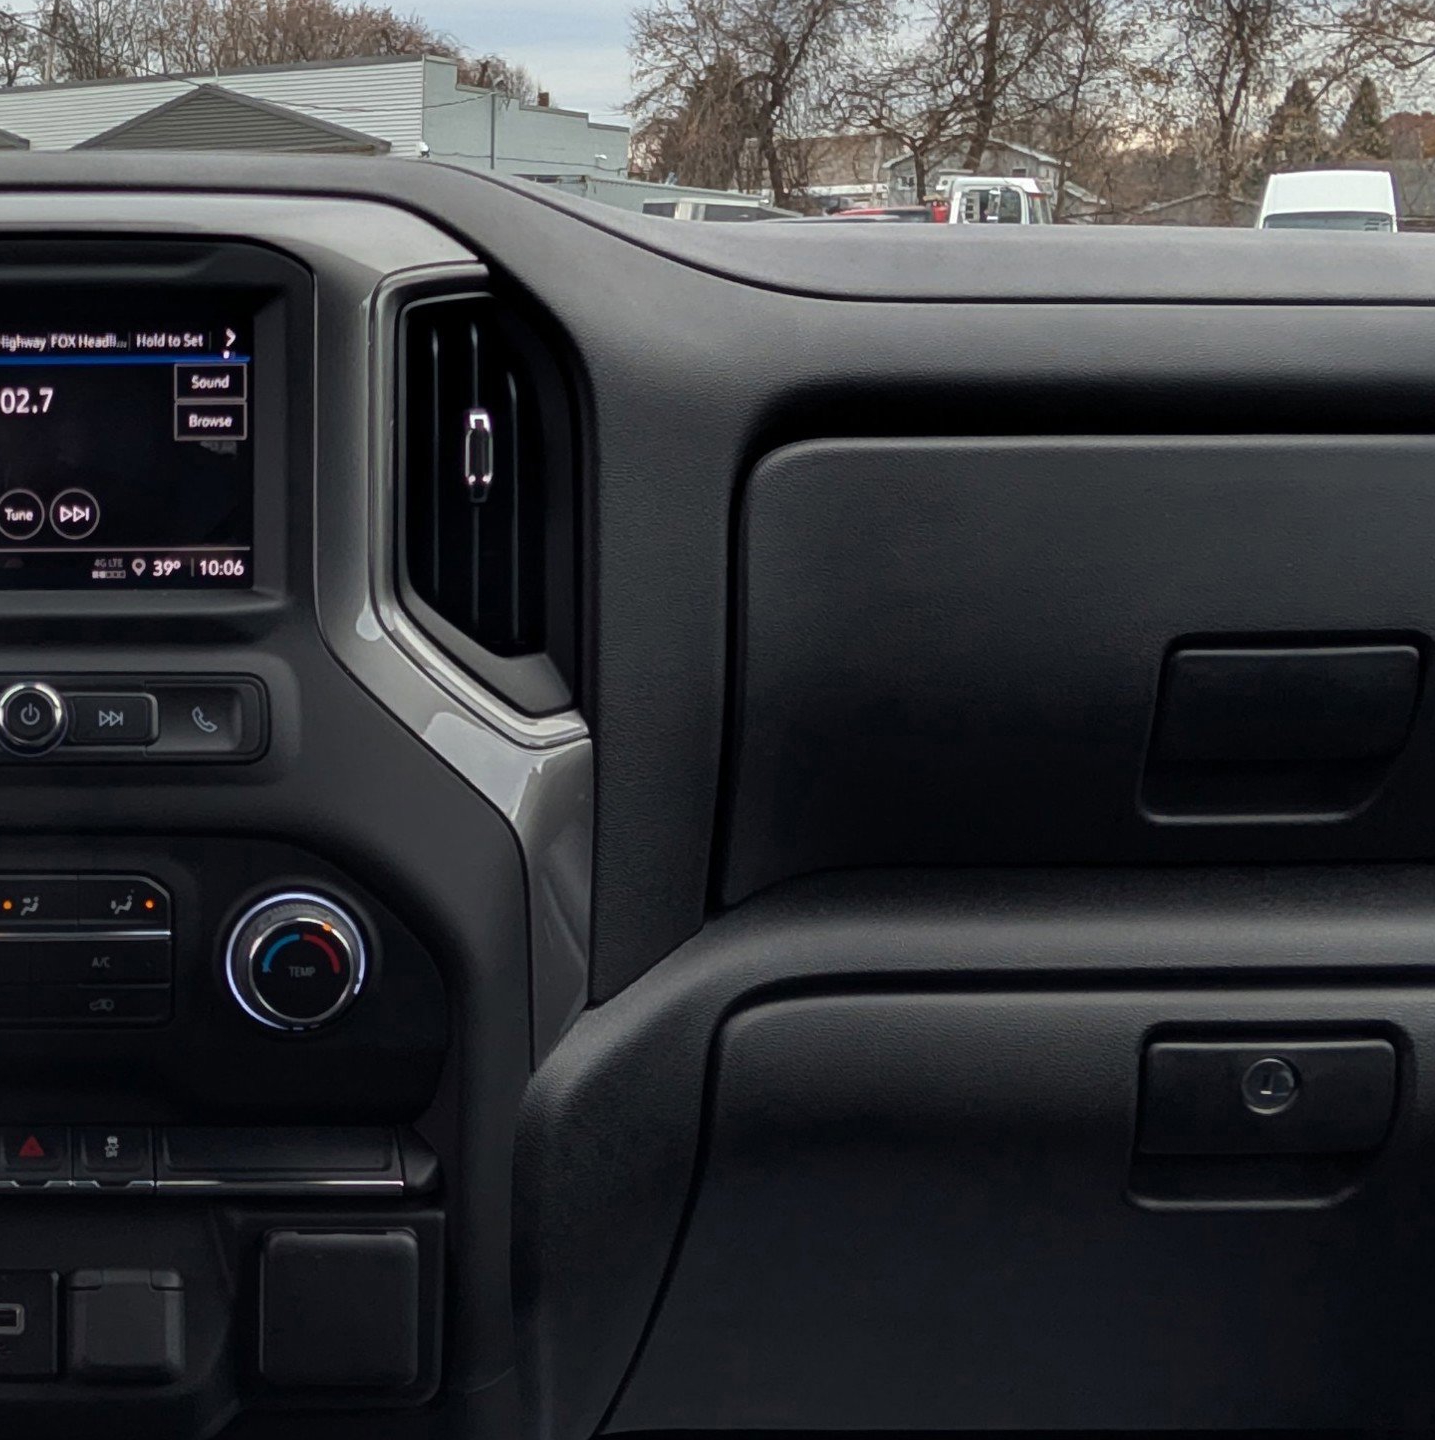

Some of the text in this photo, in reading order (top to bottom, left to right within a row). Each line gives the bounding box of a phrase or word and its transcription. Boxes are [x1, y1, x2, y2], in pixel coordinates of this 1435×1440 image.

[50, 333, 77, 349] FOX
[136, 332, 166, 348] Hold
[168, 333, 181, 348] to
[183, 331, 204, 347] Set
[191, 374, 230, 389] Sound
[188, 414, 233, 429] Browse
[4, 508, 34, 522] Tune
[199, 559, 244, 576] 10:06
[91, 955, 112, 969] A/C
[288, 965, 316, 978] TEMP
